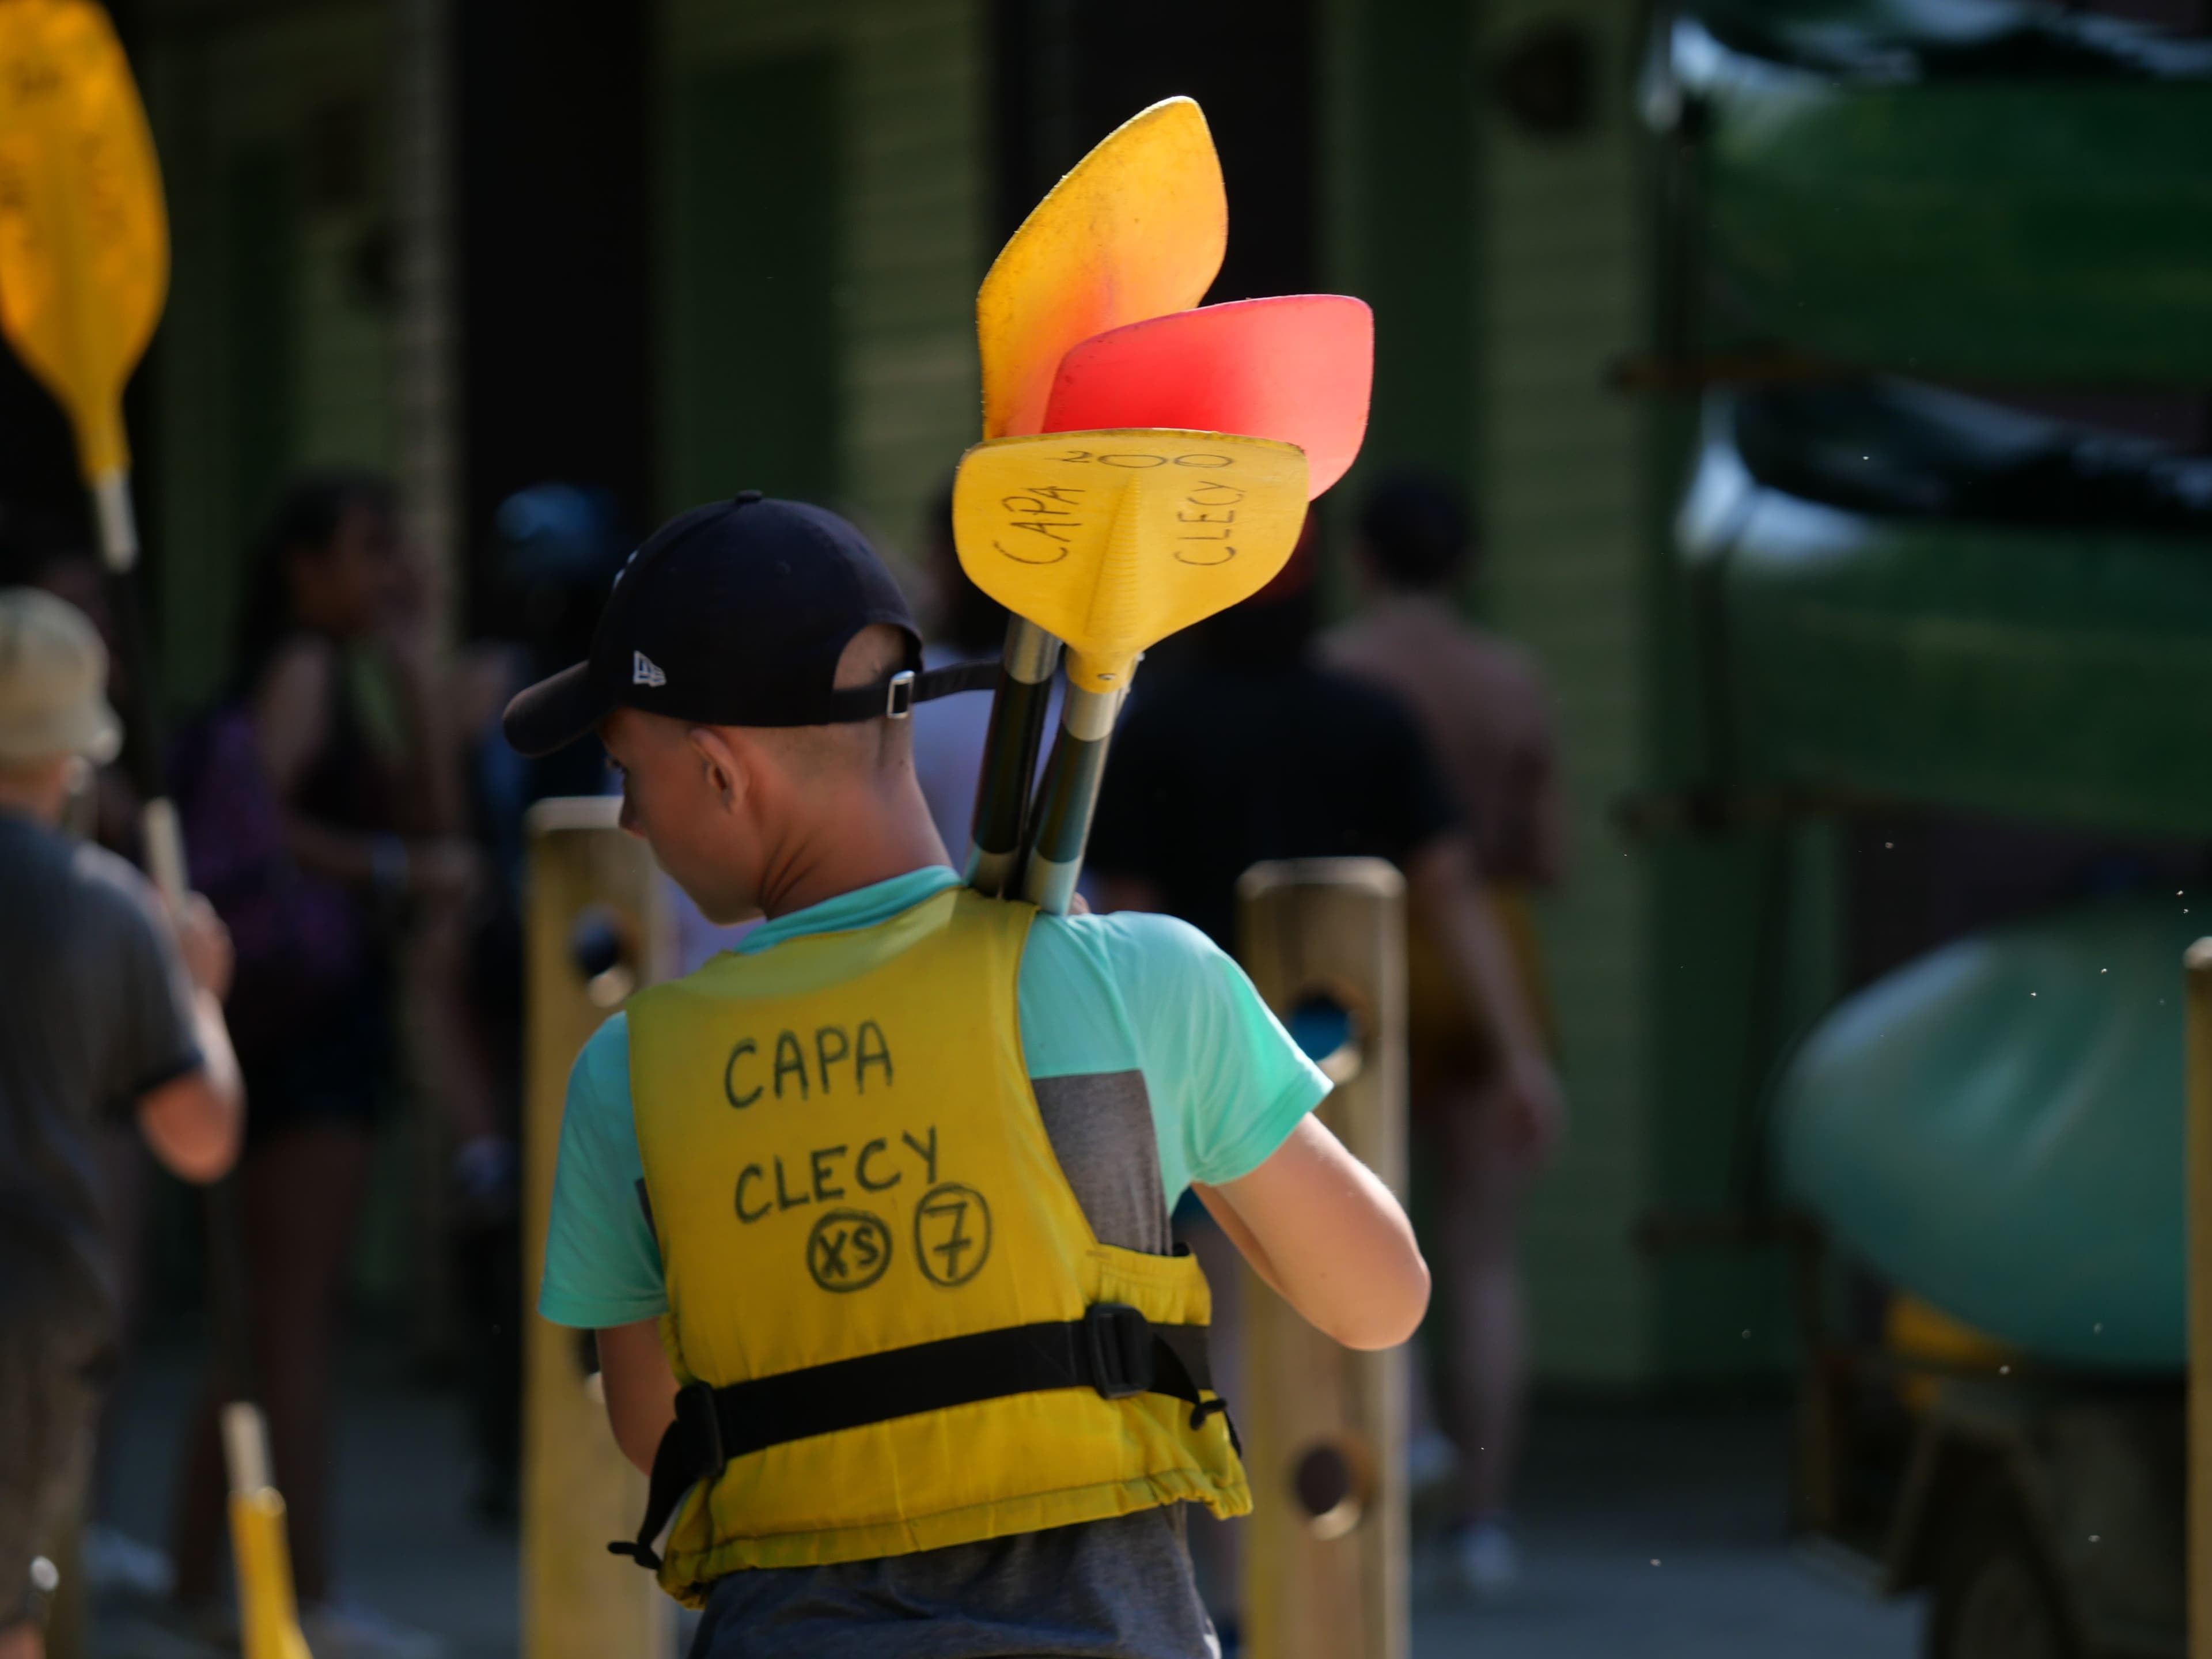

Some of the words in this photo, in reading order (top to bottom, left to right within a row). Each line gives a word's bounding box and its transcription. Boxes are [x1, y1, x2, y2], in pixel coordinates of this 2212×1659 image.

[1060, 450, 1234, 468] 200
[993, 485, 1086, 565] CAPA
[1172, 480, 1246, 566] CLECY
[724, 1020, 894, 1109] CAPA
[734, 1124, 940, 1225] CLECY
[816, 1222, 881, 1279] XS
[921, 1200, 974, 1279] 7
